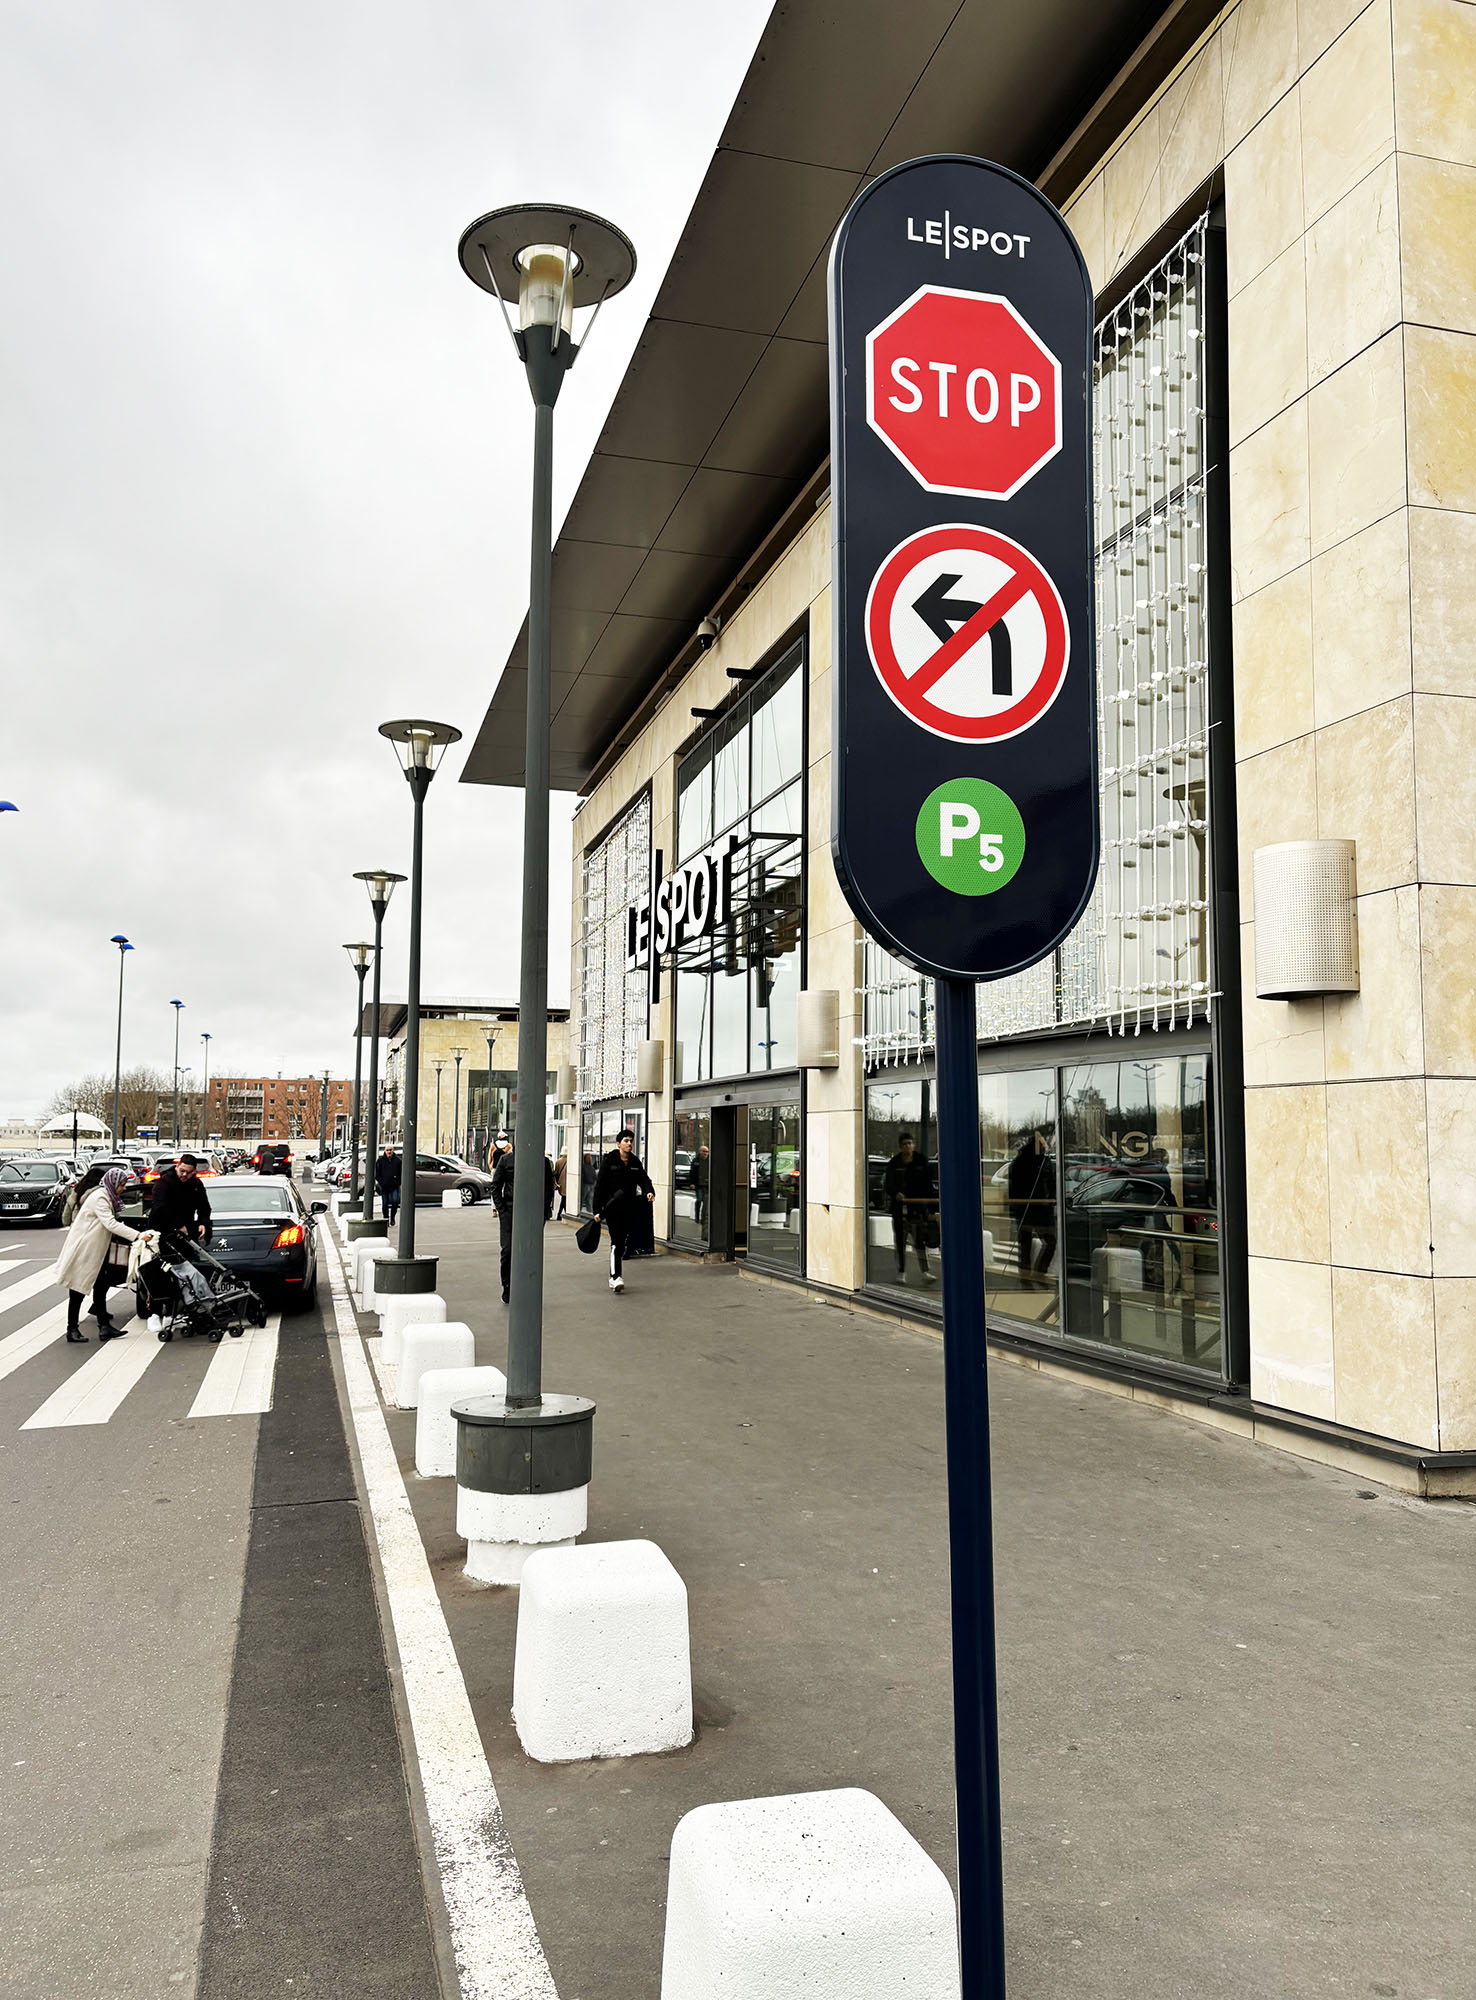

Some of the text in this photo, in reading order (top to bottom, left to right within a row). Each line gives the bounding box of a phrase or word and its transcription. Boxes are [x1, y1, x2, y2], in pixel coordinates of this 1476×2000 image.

[907, 217, 1031, 259] LE SPOT
[888, 355, 1043, 429] STOP
[646, 835, 738, 954] SPOT
